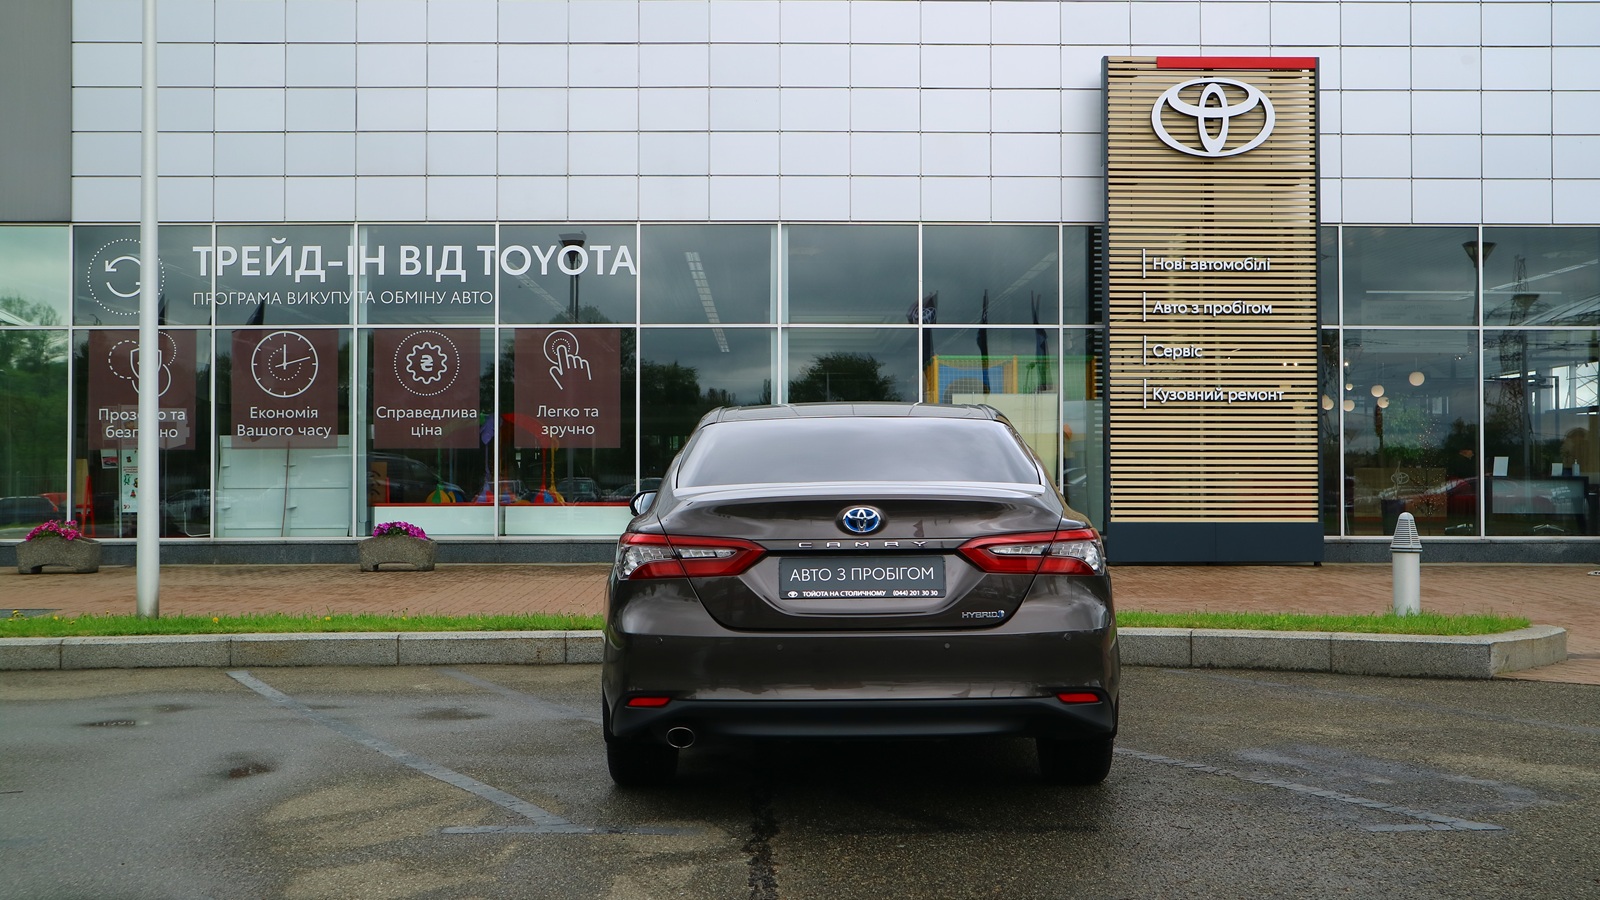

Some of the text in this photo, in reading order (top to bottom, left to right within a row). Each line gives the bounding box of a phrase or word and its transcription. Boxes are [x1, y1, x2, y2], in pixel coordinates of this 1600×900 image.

[400, 245, 467, 283] ВІД
[477, 244, 637, 276] TOYOTA
[1153, 257, 1271, 271] Нові автомобілі
[193, 292, 282, 306] ПРОГРАМА
[287, 291, 353, 305] ВИКУПУ
[380, 290, 447, 305] ОБМІНУ
[450, 290, 493, 304] АВТО
[1153, 301, 1273, 317] Авто з пробігом
[1153, 344, 1203, 360] Сервіс
[1153, 387, 1285, 404] Кузовний ремонт
[170, 410, 186, 421] та
[249, 406, 319, 419] Економія
[376, 406, 478, 421] Справедлива
[536, 405, 599, 418] Легко та
[237, 424, 332, 439] Вашого часу
[411, 423, 443, 437] ціна
[541, 424, 595, 439] зручно
[798, 541, 928, 549] CAMRY
[789, 567, 832, 582] АВТО
[851, 566, 934, 581] ПРОБІГОМ
[802, 590, 829, 598] ТОЙОТА
[961, 611, 998, 619] HYBRID
